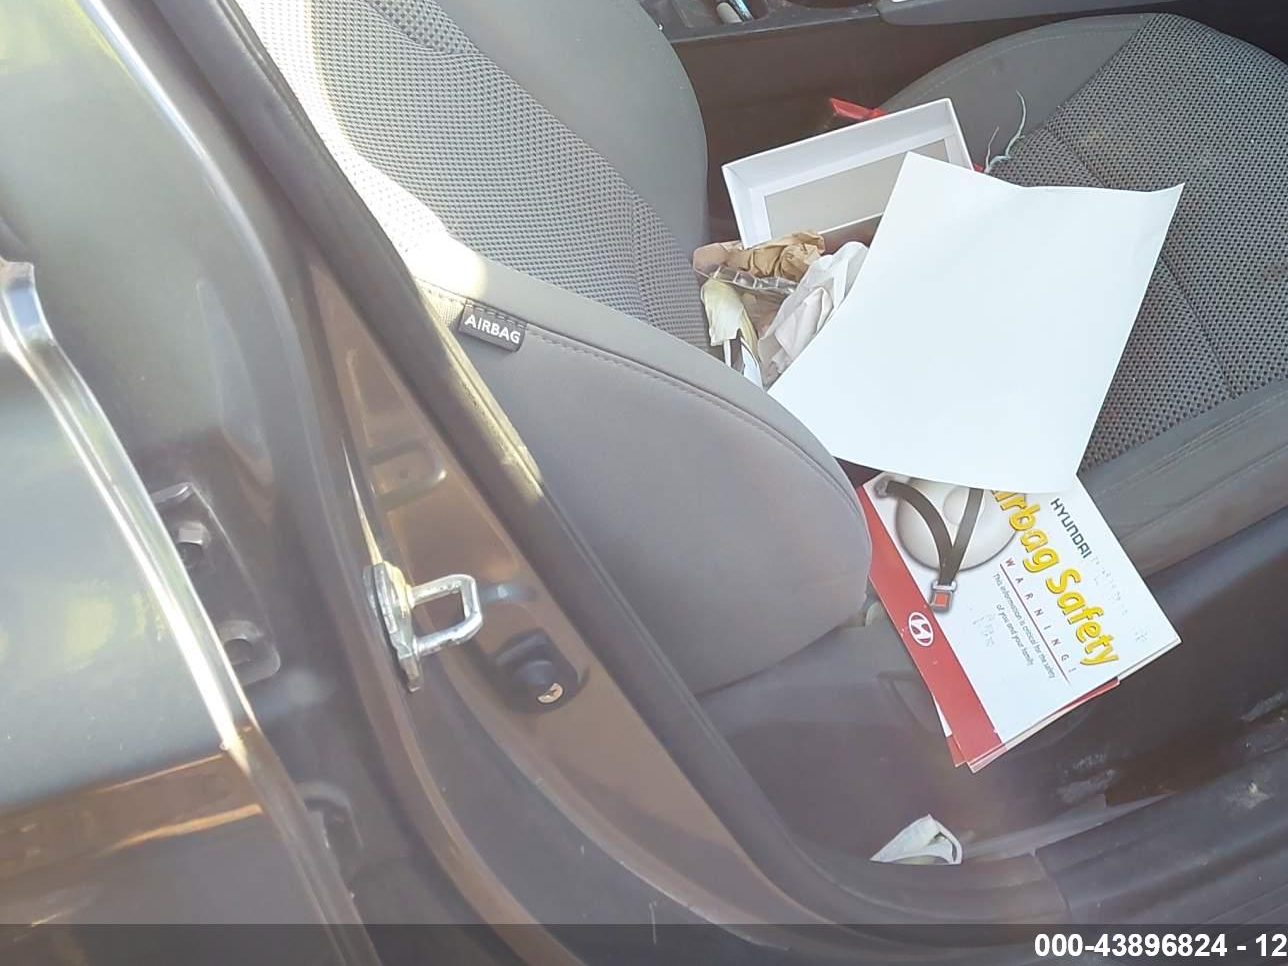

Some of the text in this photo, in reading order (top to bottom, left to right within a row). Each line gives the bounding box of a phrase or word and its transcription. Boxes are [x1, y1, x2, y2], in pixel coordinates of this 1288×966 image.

[464, 315, 521, 344] AIRBAG
[1051, 498, 1093, 559] HYUNDAI
[991, 489, 1119, 666] rbag Safety
